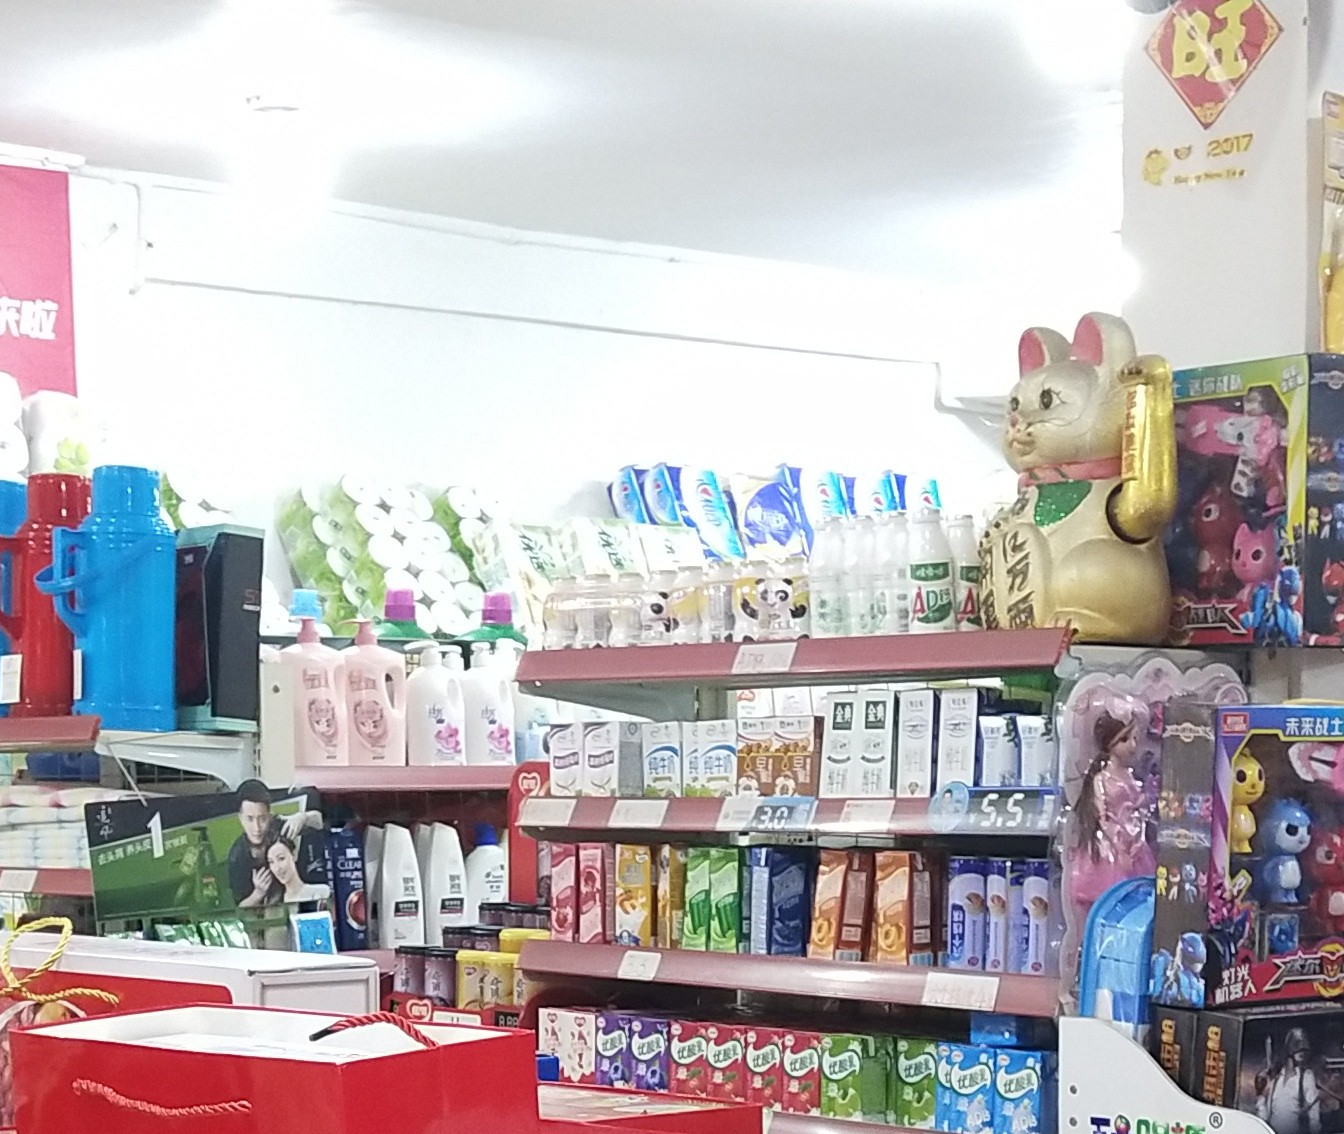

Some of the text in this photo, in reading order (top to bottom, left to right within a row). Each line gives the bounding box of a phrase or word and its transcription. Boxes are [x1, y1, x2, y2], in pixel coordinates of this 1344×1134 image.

[1207, 133, 1254, 158] 2017
[1284, 717, 1344, 737] 未来战士
